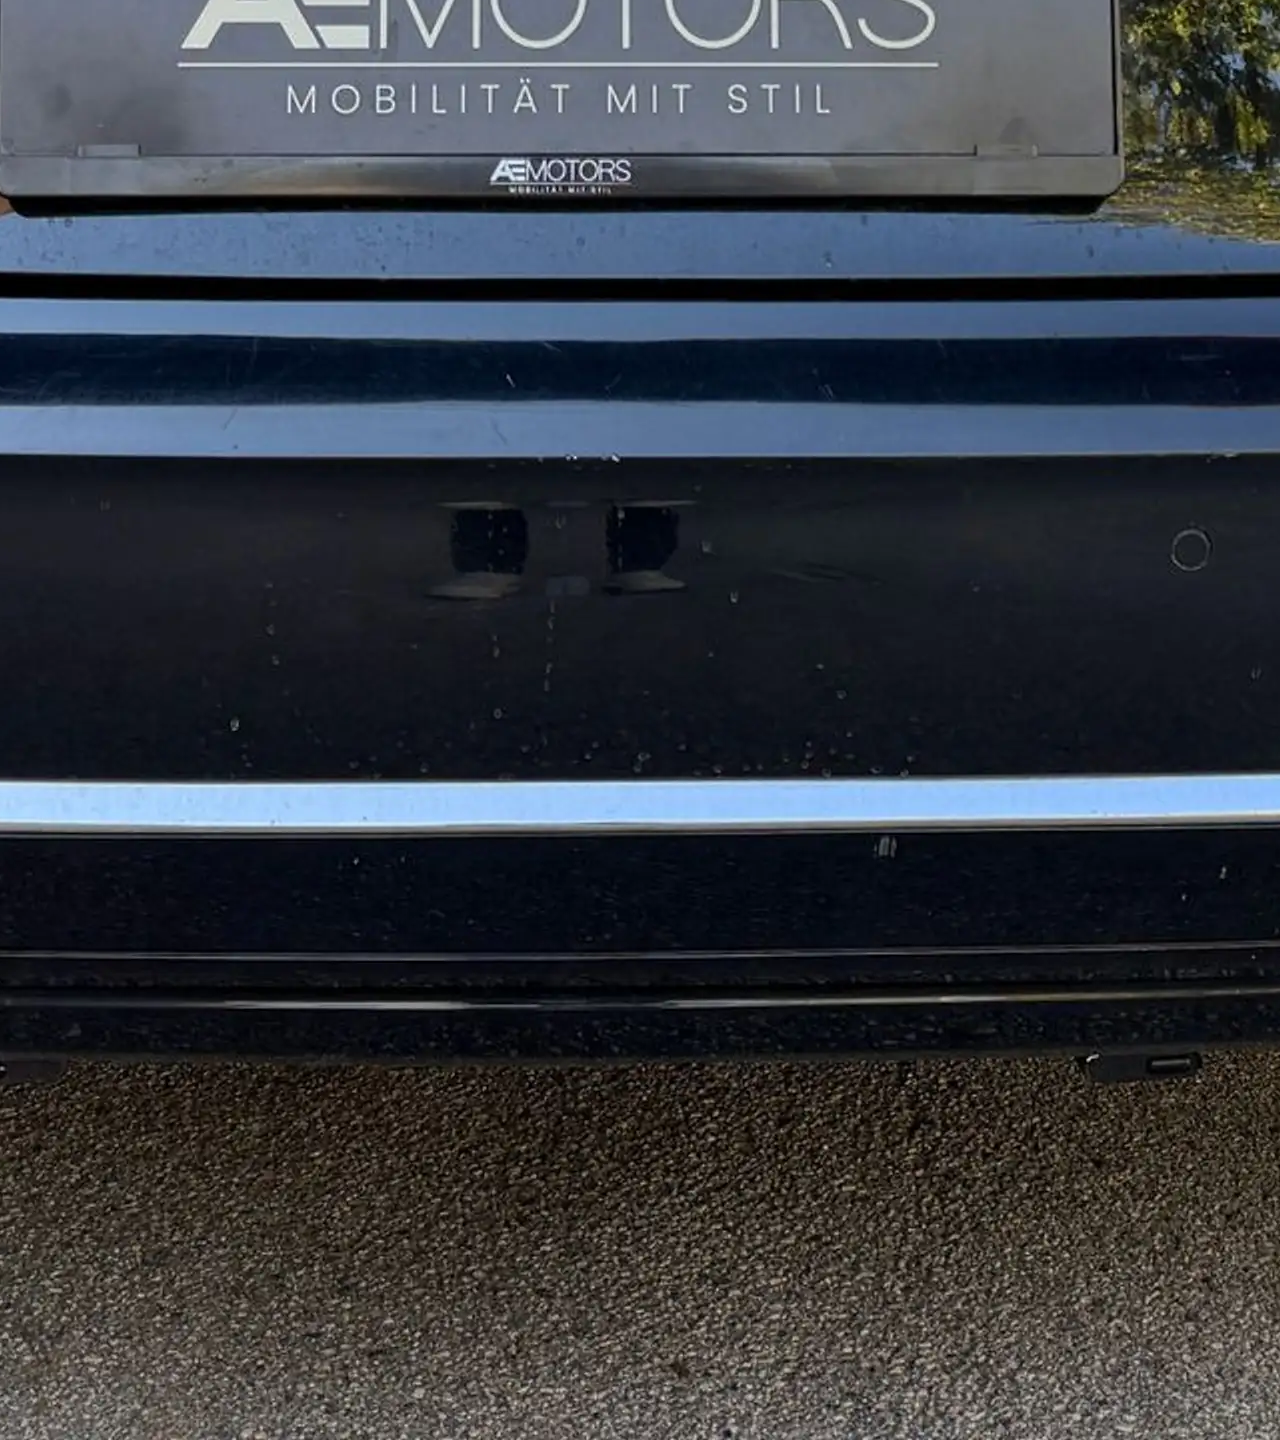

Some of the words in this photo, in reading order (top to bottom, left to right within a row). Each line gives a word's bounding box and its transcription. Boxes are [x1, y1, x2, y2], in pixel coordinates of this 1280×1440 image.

[287, 77, 571, 115] MOBILITÄT
[607, 83, 692, 115] MIT
[727, 83, 831, 115] STIL
